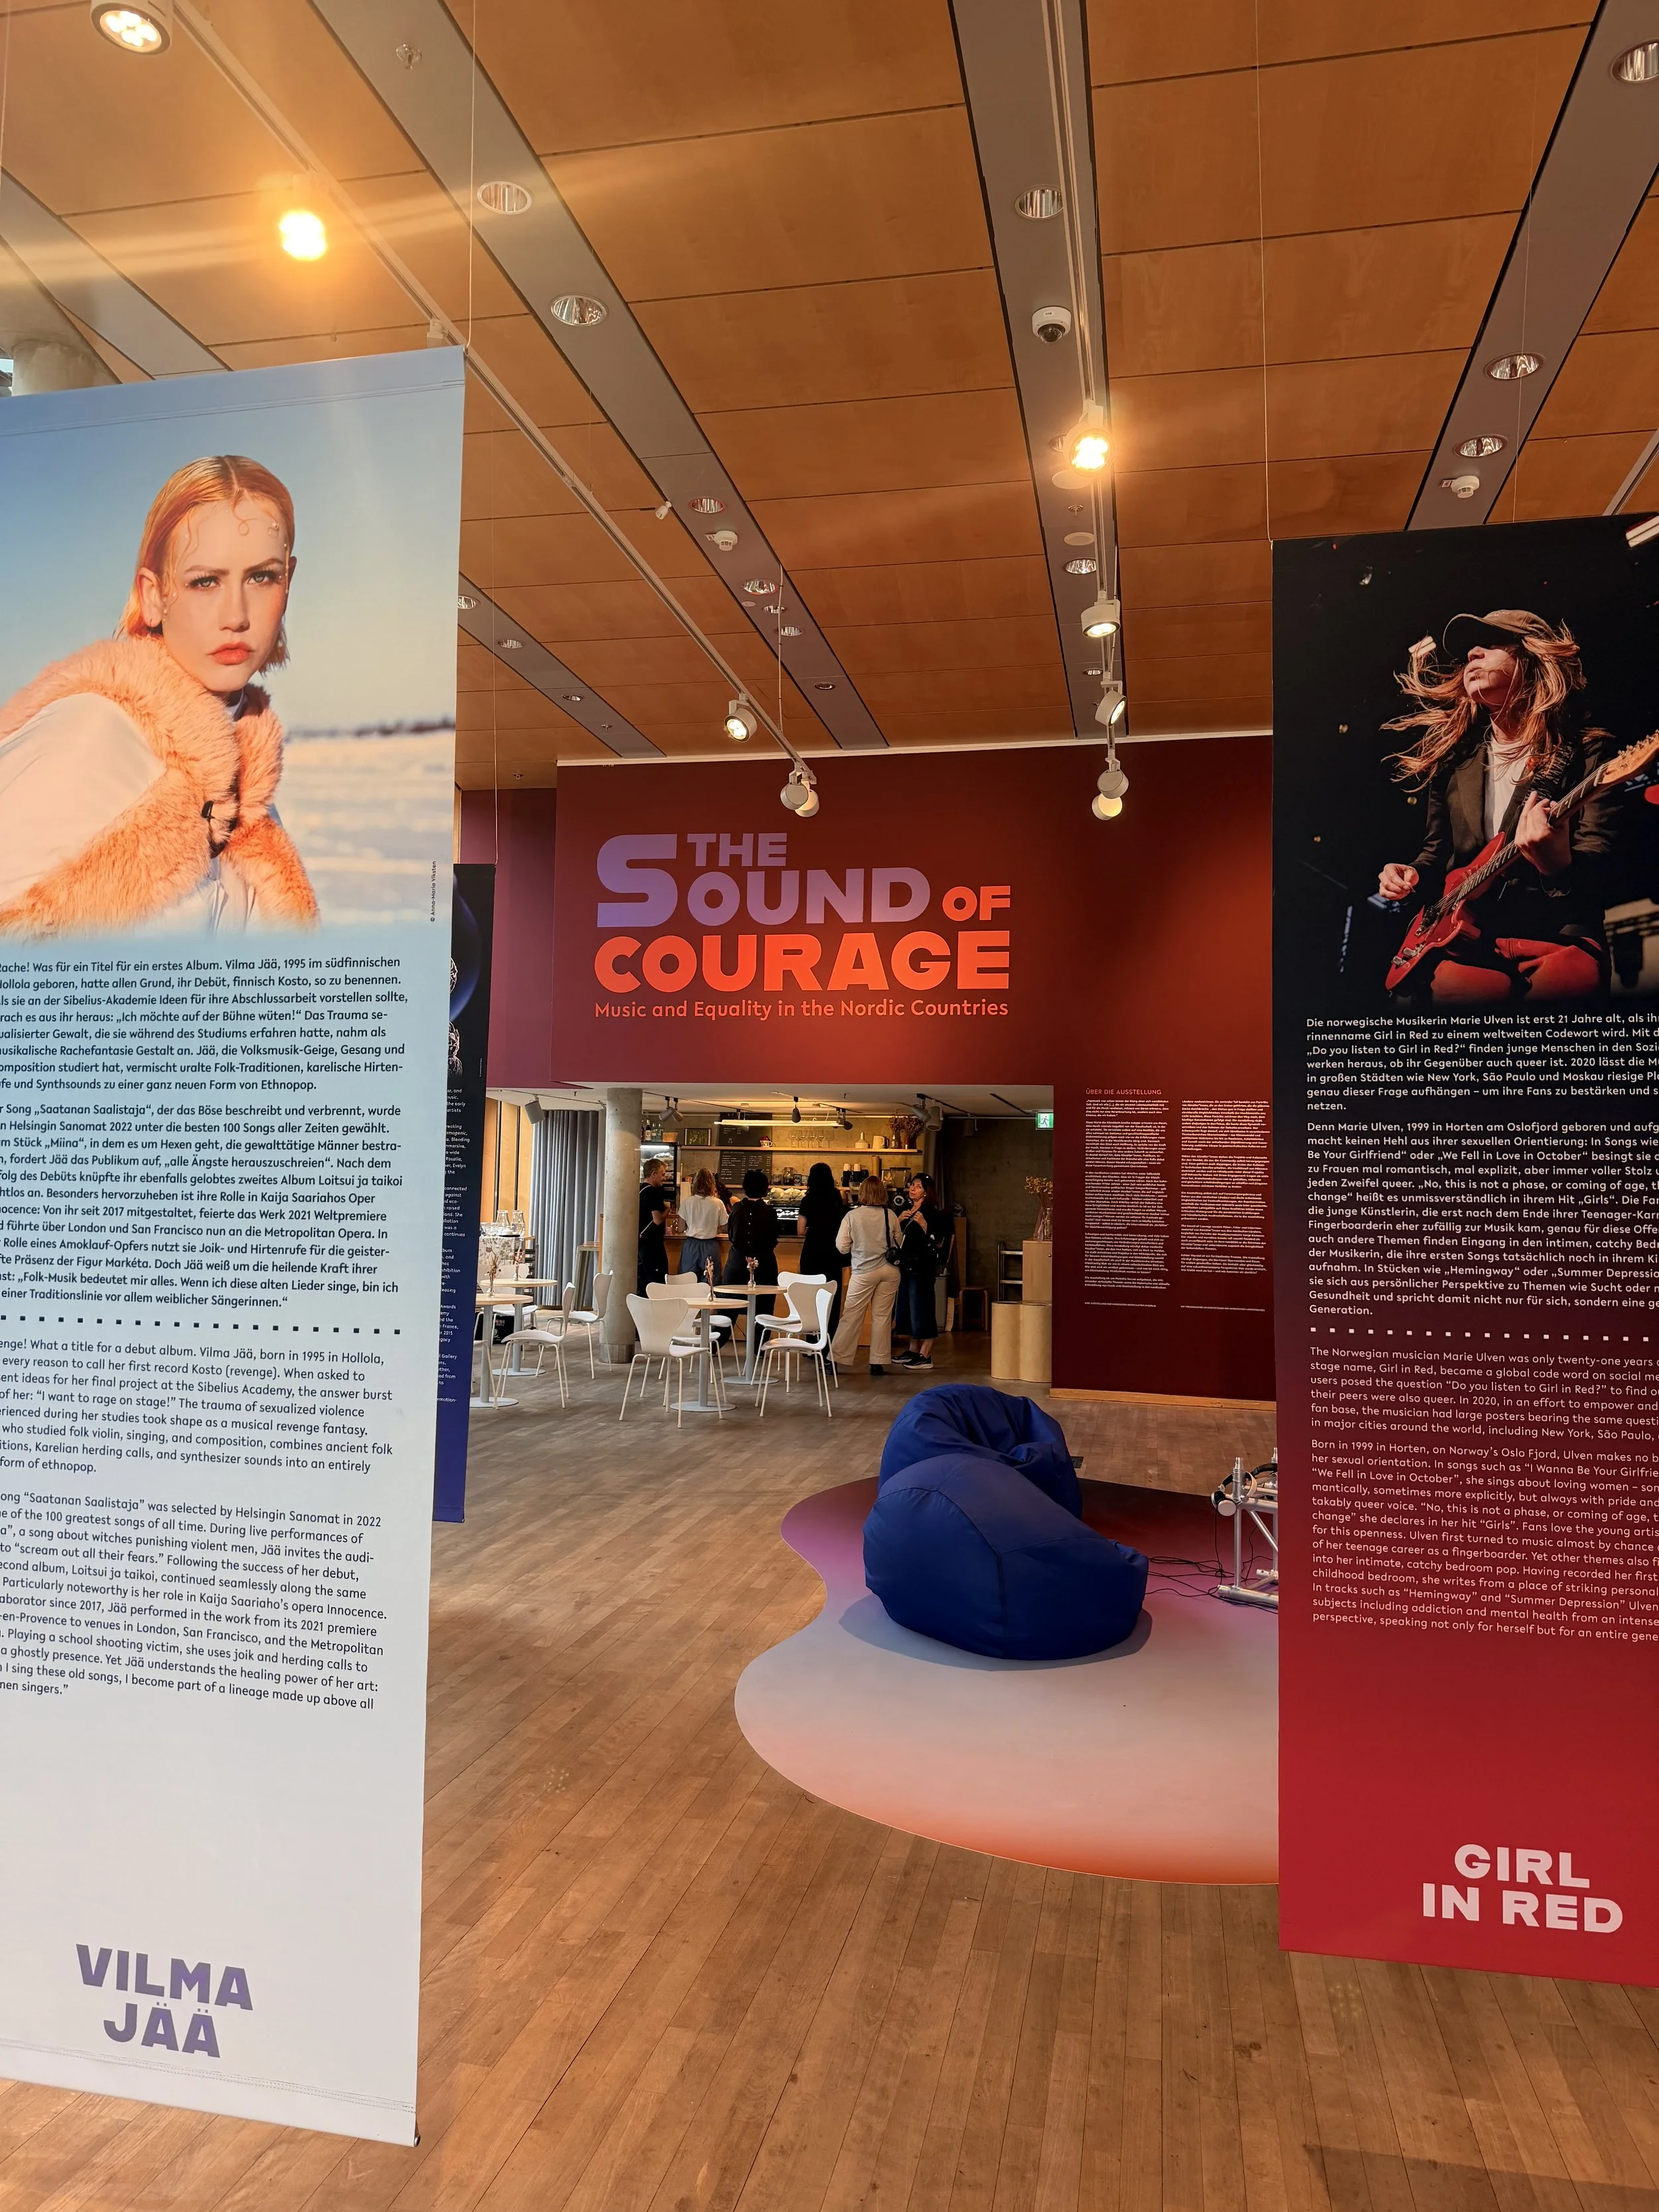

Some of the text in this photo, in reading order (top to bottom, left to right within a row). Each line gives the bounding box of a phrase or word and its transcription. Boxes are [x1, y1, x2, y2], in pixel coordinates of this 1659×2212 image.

[687, 833, 787, 867] THE
[597, 834, 1011, 927] SOUND OF
[33, 963, 53, 972] Was
[56, 962, 71, 972] für
[73, 962, 88, 972] ein
[91, 961, 113, 972] Titel
[115, 961, 131, 971] für
[133, 961, 149, 971] ein
[152, 961, 183, 971] erstes
[186, 960, 222, 970] Album.
[226, 959, 255, 970] Vilma
[258, 958, 281, 970] Jää,
[284, 959, 306, 968] 1995
[309, 958, 322, 968] im
[325, 956, 400, 968] südfinnischen
[594, 930, 1010, 993] COURAGE
[595, 999, 1009, 1021] Music and Equality in the Nordic Countries
[1307, 1018, 1323, 1027] Die
[1327, 1017, 1393, 1028] norwegische
[1396, 1016, 1447, 1025] Musikerin
[1451, 1015, 1480, 1025] Marie
[1484, 1015, 1513, 1024] Ulven
[1517, 1015, 1530, 1023] ist
[1558, 1015, 1567, 1023] 21
[1571, 1014, 1602, 1023] Jahre
[1606, 1013, 1624, 1023] alt,
[1628, 1013, 1644, 1022] als
[1647, 1013, 1659, 1022] ih
[9, 1120, 389, 1136] Helsingin Sanomat 2022 unter die besten 100 Songs aller Zeiten gewählt.
[1308, 1136, 1342, 1145] macht
[1346, 1136, 1380, 1145] keinen
[1384, 1136, 1407, 1145] Hehl
[1433, 1136, 1458, 1145] ihrer
[1461, 1136, 1510, 1145] sexuellen
[1514, 1137, 1587, 1148] Orientierung:
[1591, 1137, 1601, 1145] In
[1605, 1137, 1637, 1148] Songs
[1640, 1137, 1658, 1146] wie
[1309, 1276, 1323, 1285] sie
[1327, 1276, 1347, 1286] sich
[1372, 1278, 1439, 1289] persönlicher
[1443, 1280, 1504, 1291] Perspektive
[1522, 1281, 1565, 1291] Themen
[1569, 1282, 1587, 1291] wie
[1591, 1283, 1623, 1292] Sucht
[1626, 1283, 1650, 1292] oder
[1309, 1305, 1372, 1315] Generation.
[2, 1358, 365, 1381] every reason to call her first record Kosto (revenge). When asked to
[1311, 1389, 1336, 1399] their
[1399, 1393, 1420, 1402] also
[1423, 1396, 1456, 1405] queer.
[1460, 1396, 1469, 1404] In
[1473, 1396, 1499, 1407] 2020,
[1503, 1396, 1512, 1406] in
[1533, 1398, 1565, 1408] effort
[1568, 1400, 1580, 1408] to
[1583, 1402, 1634, 1412] empower
[1637, 1401, 1658, 1410] and
[3, 1577, 387, 1619] Particularly noteworthy is her role in Kaija Saariaho’s opera Innocence.
[1313, 1583, 1322, 1591] In
[1325, 1584, 1358, 1593] tracks
[1361, 1585, 1385, 1595] such
[1404, 1588, 1477, 1603] “Hemingway”
[1480, 1593, 1501, 1602] and
[1505, 1593, 1555, 1605] “Summer
[1559, 1597, 1625, 1609] Depression”
[1629, 1601, 1658, 1611] Ulven
[1455, 1844, 1590, 1888] GIRL
[1423, 1883, 1623, 1933] IN RED
[76, 1943, 253, 2011] VILMA
[104, 2002, 220, 2058] JÄÄ
